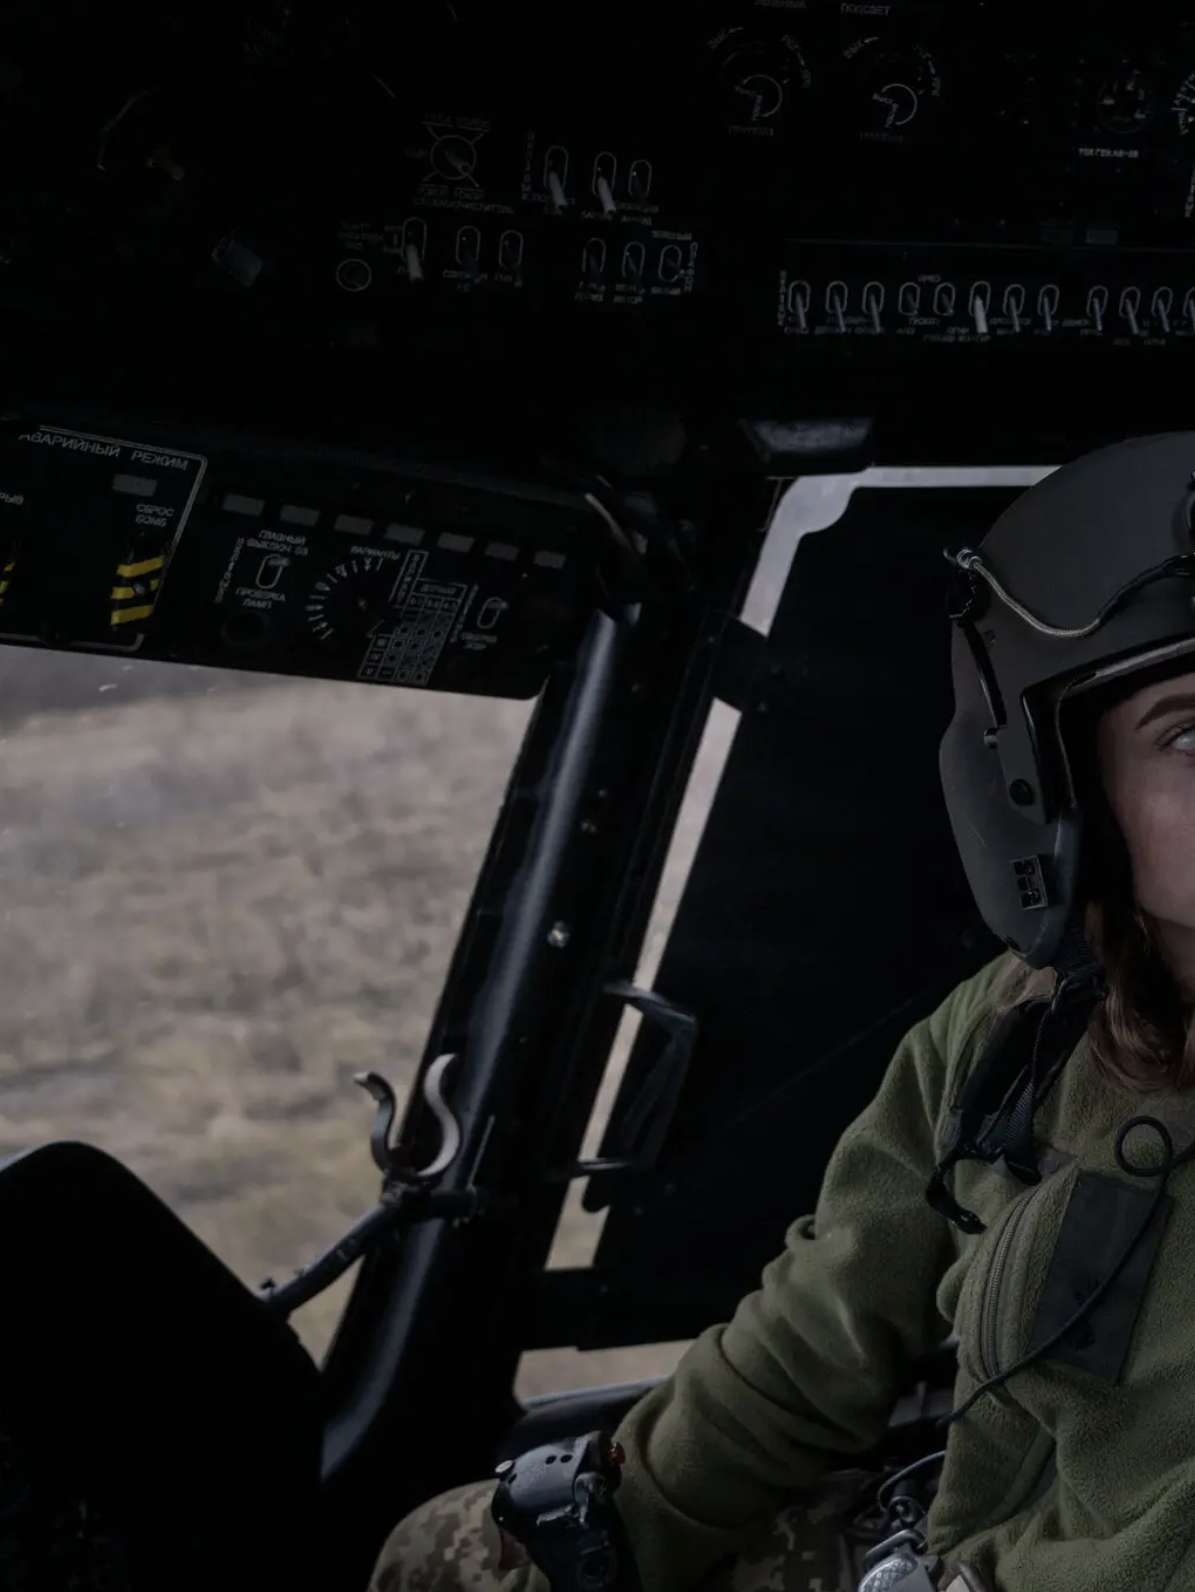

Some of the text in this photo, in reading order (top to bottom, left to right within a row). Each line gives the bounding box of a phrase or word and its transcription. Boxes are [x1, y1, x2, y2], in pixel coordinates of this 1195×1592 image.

[131, 449, 190, 471] РЕЖИМ
[135, 503, 175, 518] СБРОС
[134, 514, 168, 528] БОМБ
